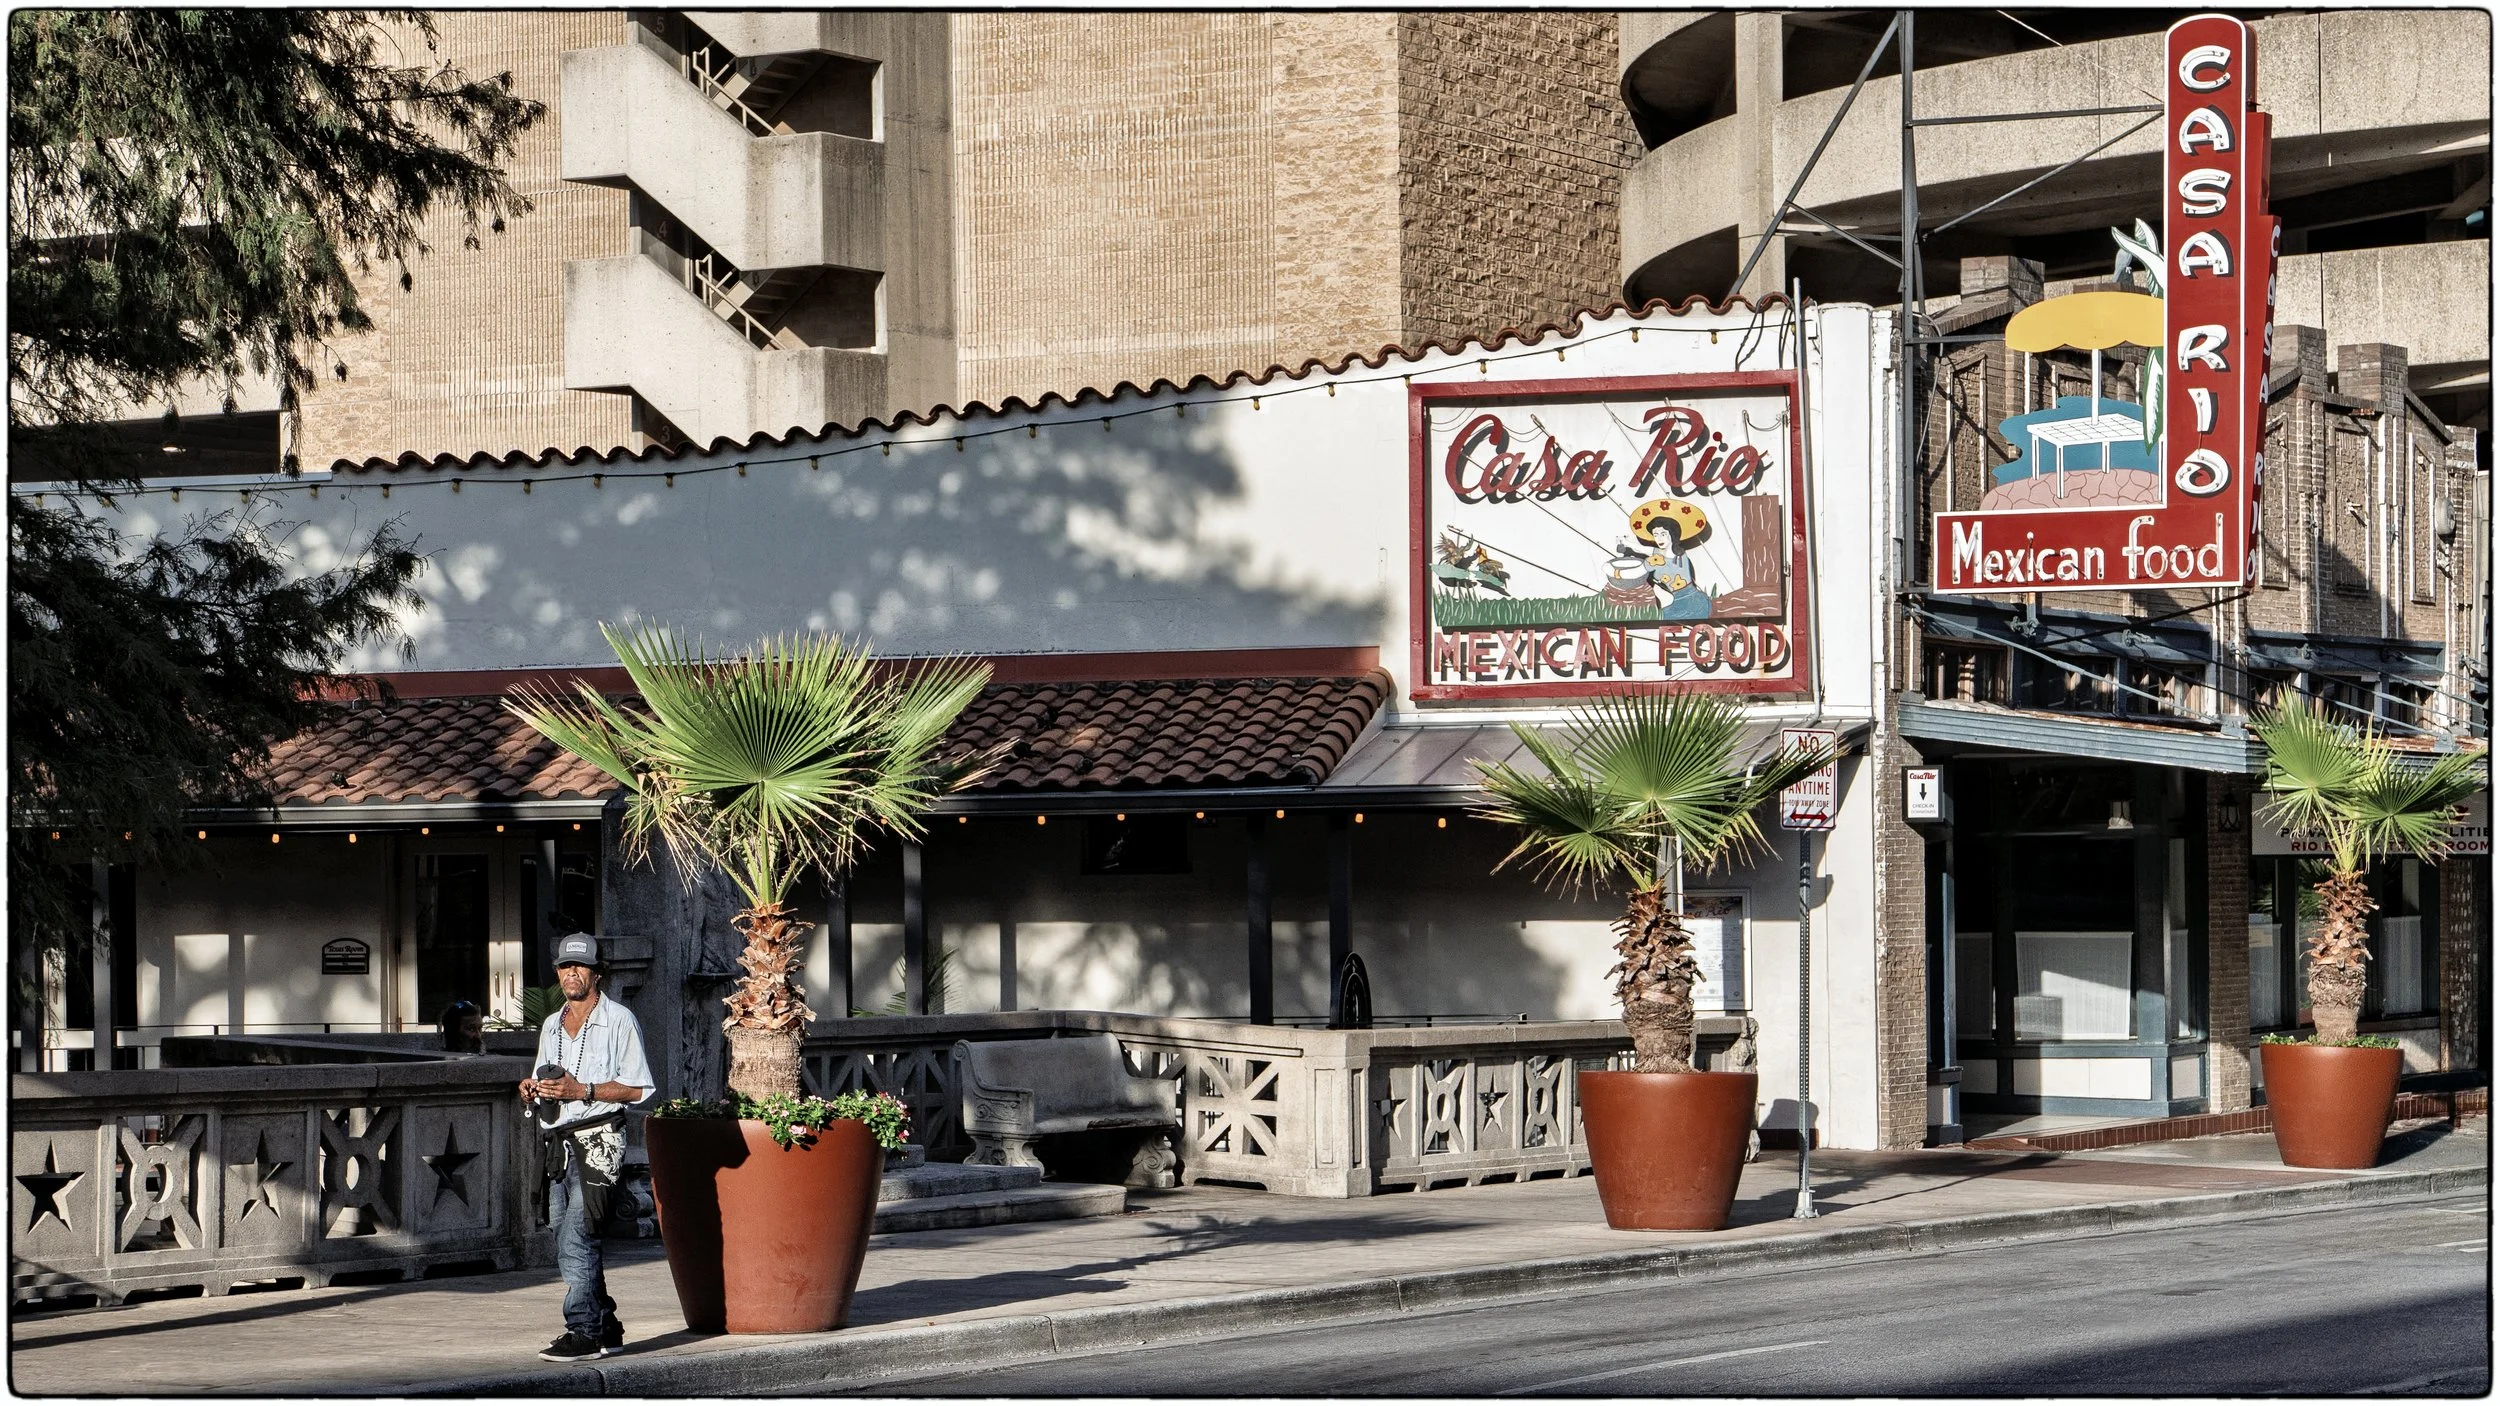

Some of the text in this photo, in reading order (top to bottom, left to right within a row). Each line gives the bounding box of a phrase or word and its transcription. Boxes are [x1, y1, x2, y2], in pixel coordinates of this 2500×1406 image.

[656, 16, 665, 34] 5
[658, 220, 667, 238] 4
[2174, 45, 2235, 497] CASA RIO
[2245, 224, 2282, 582] CASA RIO
[1445, 406, 1774, 500] Casa Rio
[1951, 511, 2224, 585] Mexican food
[1432, 622, 1789, 676] MEXICAN FOOD
[1797, 735, 1820, 754] NO
[1788, 781, 1831, 796] ANYTIME
[1816, 800, 1830, 808] ZONE
[2291, 841, 2318, 852] RIO
